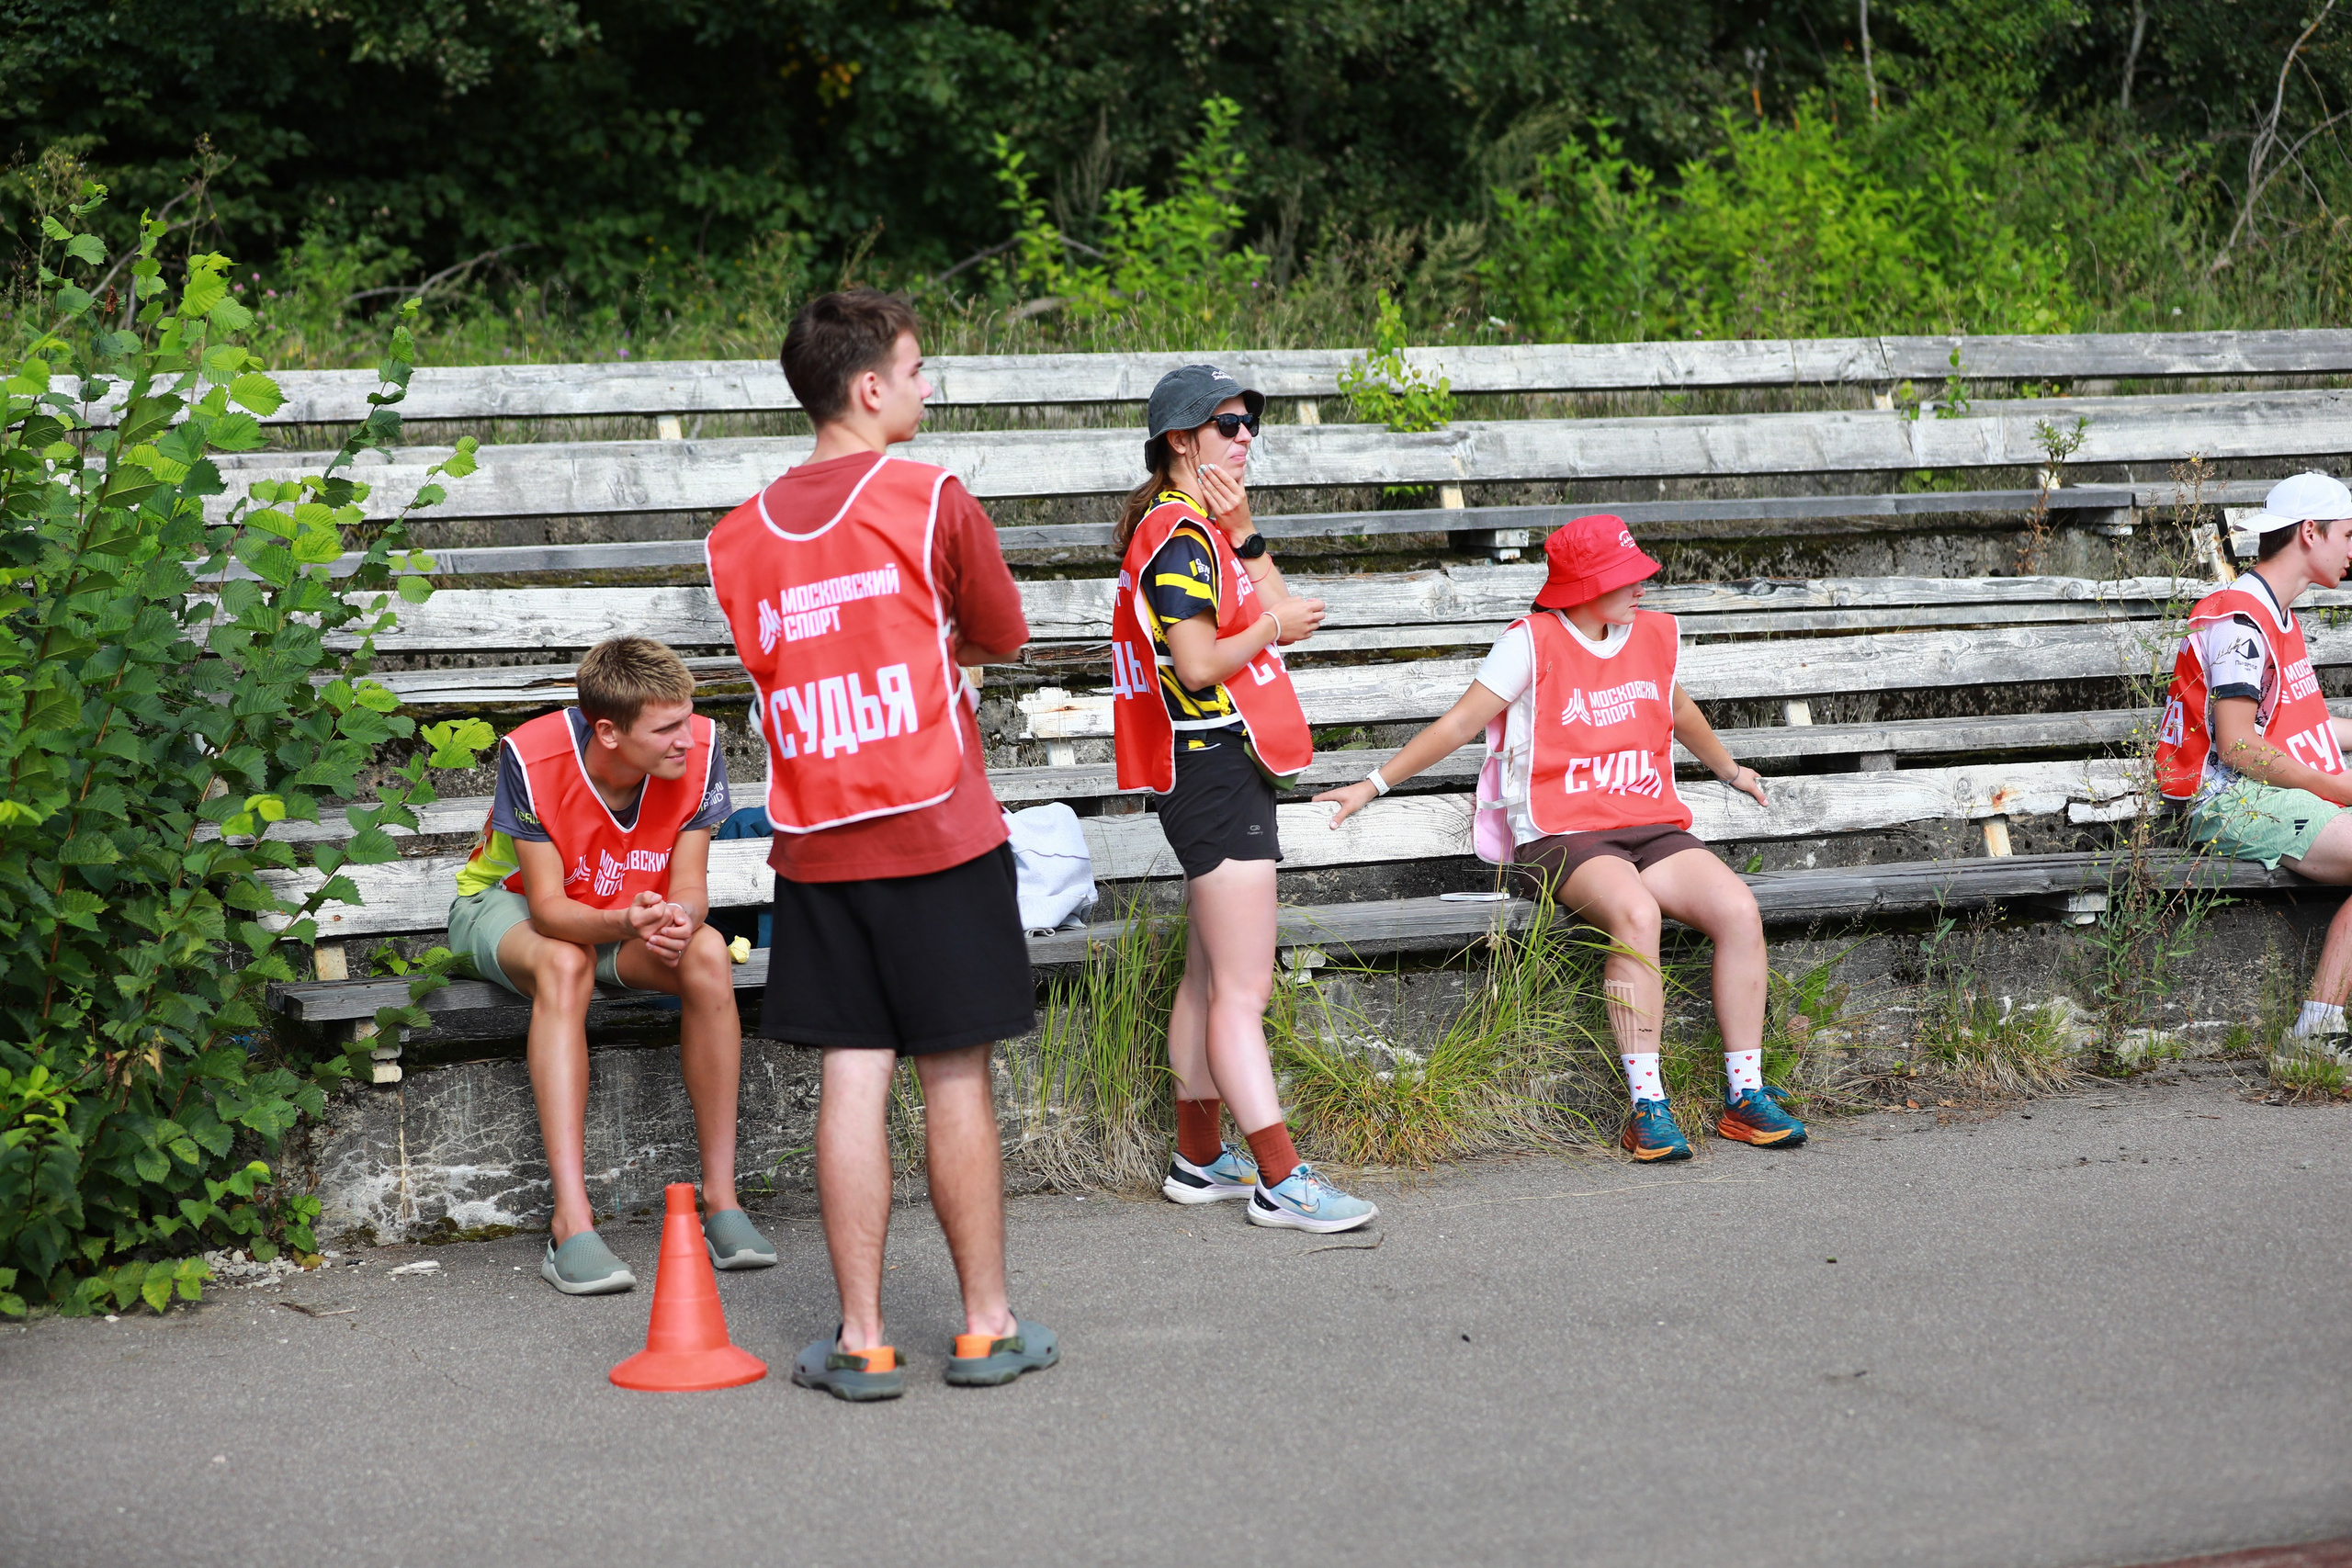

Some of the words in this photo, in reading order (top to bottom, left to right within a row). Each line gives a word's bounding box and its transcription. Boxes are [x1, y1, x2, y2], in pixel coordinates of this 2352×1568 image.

[781, 563, 900, 615] МОСКОВСКИЙ
[783, 605, 841, 643] СПОРТ
[770, 662, 919, 760] СУДЬЯ
[1592, 701, 1636, 727] СПОРТ
